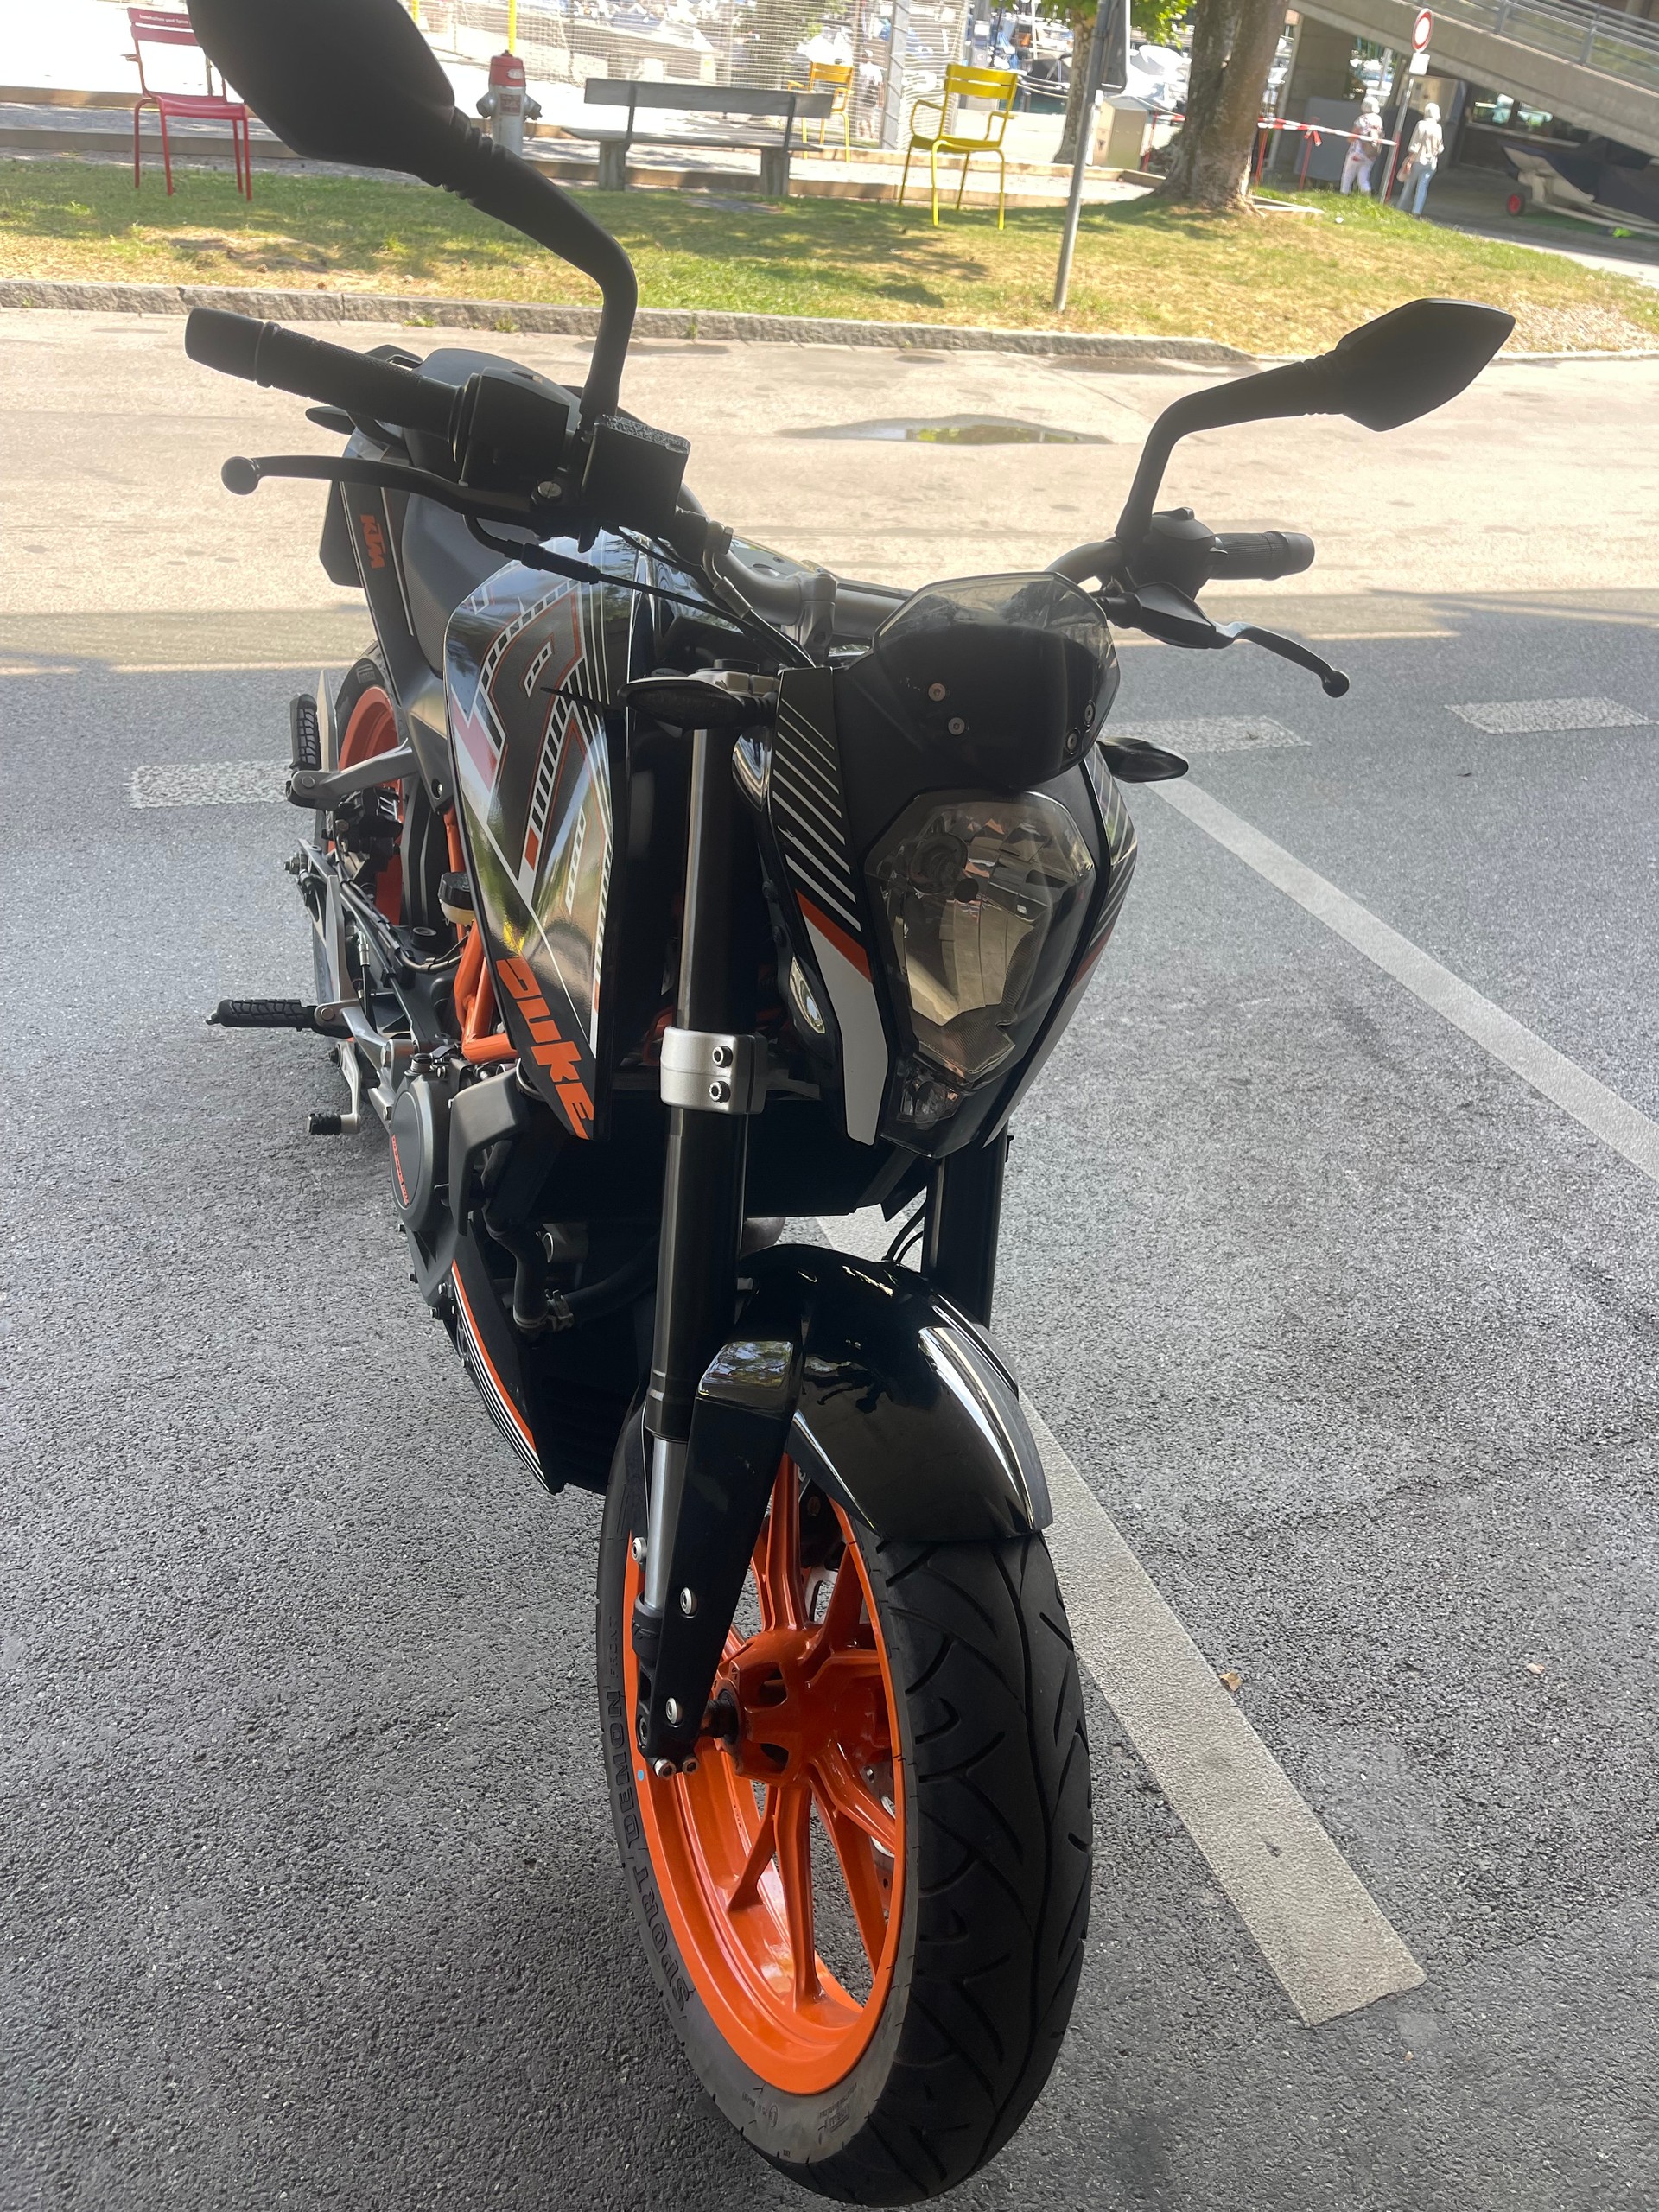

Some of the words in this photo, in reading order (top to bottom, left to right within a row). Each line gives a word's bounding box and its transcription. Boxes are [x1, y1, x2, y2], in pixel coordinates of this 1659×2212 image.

[359, 514, 386, 569] KTM
[496, 957, 594, 1140] DUKE
[607, 1690, 640, 1849] DEMON
[632, 1865, 690, 2012] SPORT
